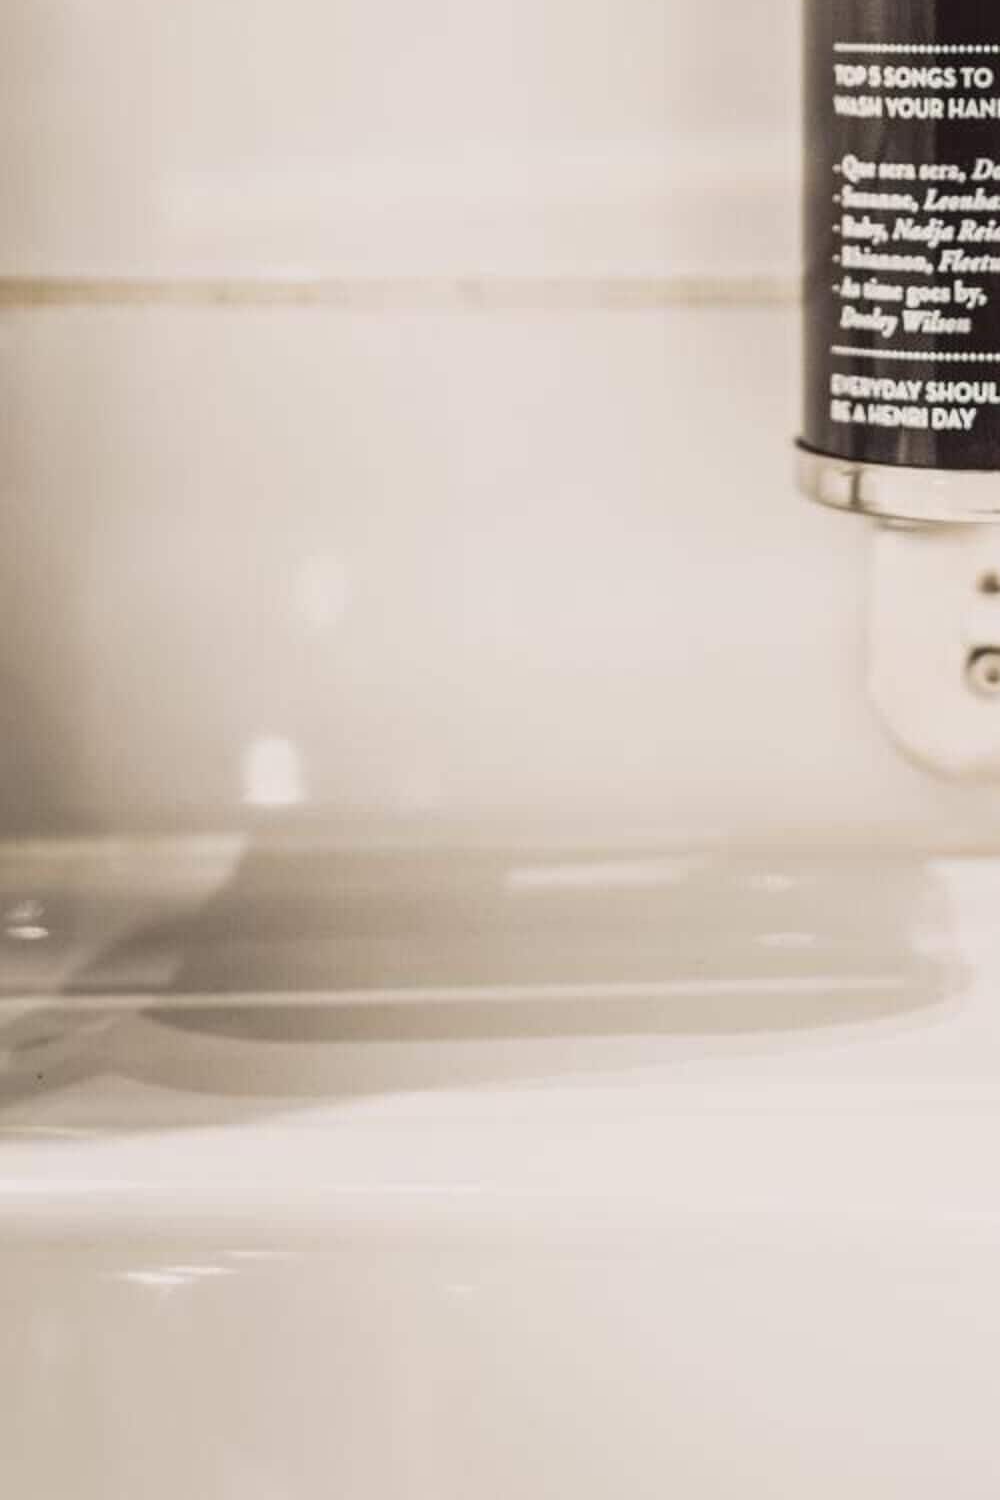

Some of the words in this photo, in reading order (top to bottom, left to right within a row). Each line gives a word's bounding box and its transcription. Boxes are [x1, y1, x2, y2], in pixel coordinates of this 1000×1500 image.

[833, 64, 867, 87] TOP
[868, 65, 882, 87] 5
[883, 66, 957, 88] SONGS
[960, 67, 993, 88] TO
[833, 95, 882, 117] WASH
[885, 97, 944, 119] YOUR
[863, 277, 904, 301] time
[906, 285, 951, 308] goes
[902, 310, 972, 333] Wilson
[831, 373, 923, 401] EVERYDAY
[831, 399, 852, 422] BE
[853, 403, 866, 422] A
[868, 404, 928, 429] HENRI
[932, 407, 976, 430] DAY
